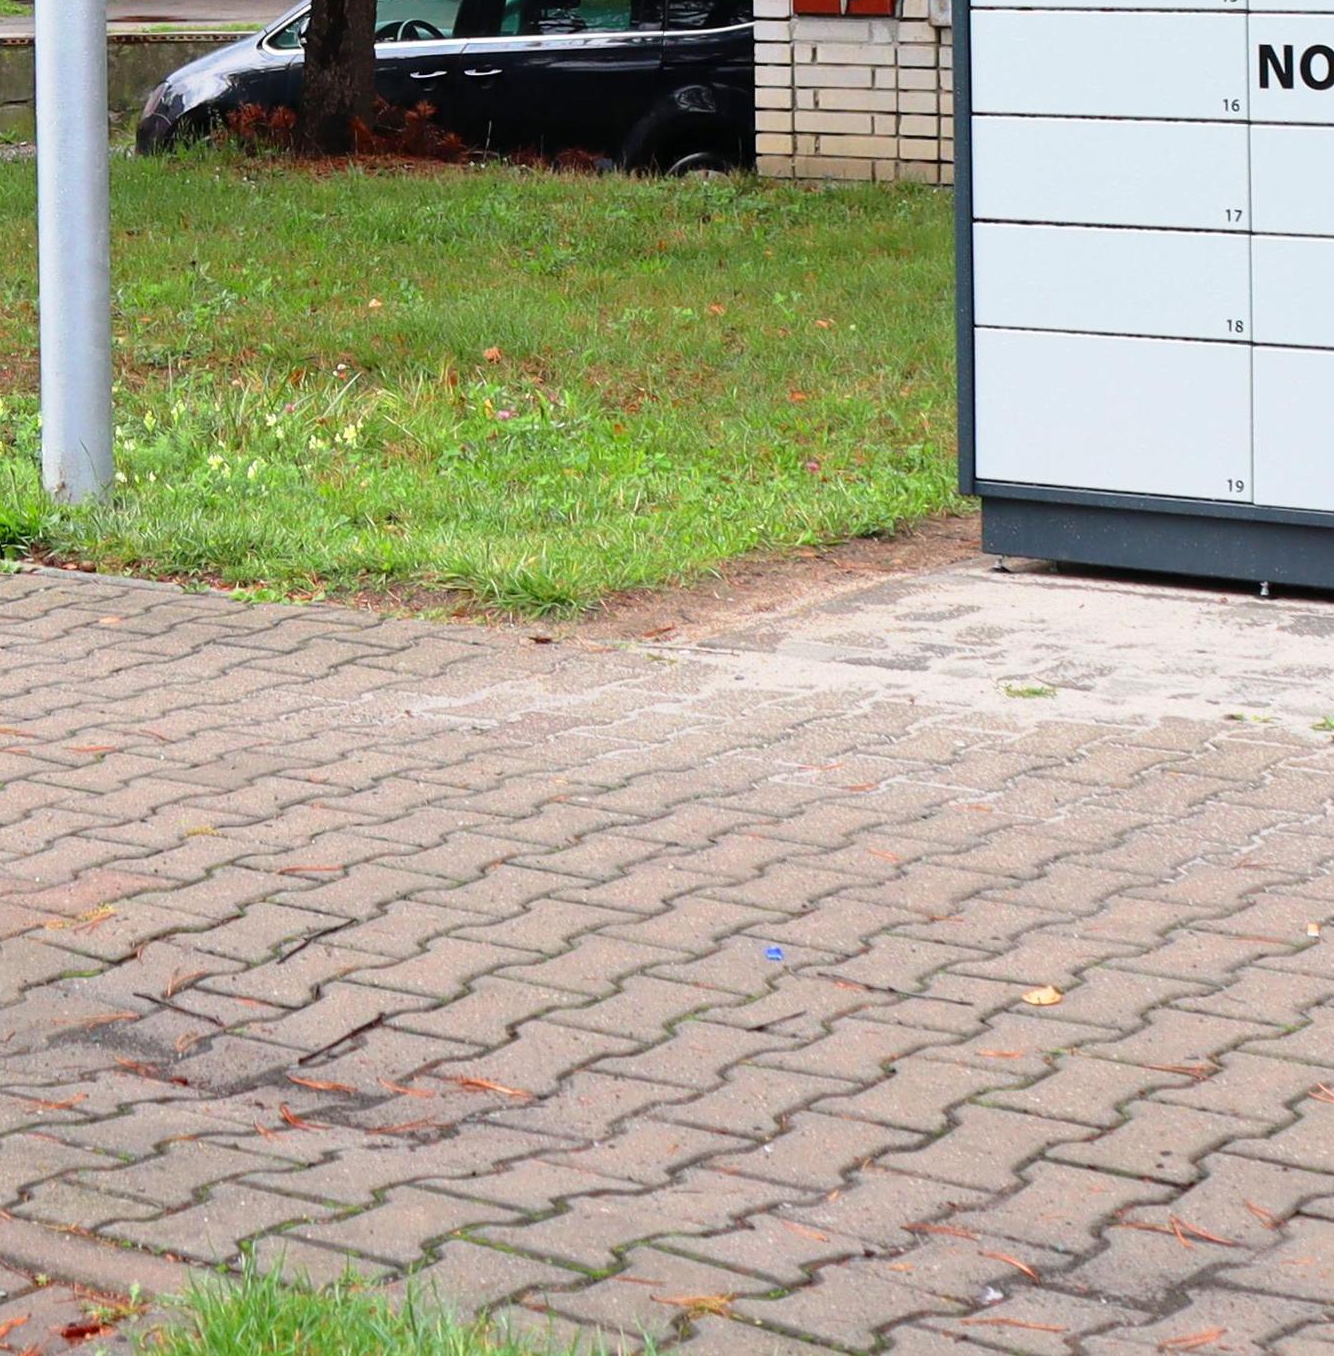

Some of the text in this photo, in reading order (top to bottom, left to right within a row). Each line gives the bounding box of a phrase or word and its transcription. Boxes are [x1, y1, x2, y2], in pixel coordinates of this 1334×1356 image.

[1223, 99, 1240, 112] 16
[1225, 209, 1242, 221] 17
[1226, 320, 1244, 332] 18
[1227, 480, 1245, 493] 19
